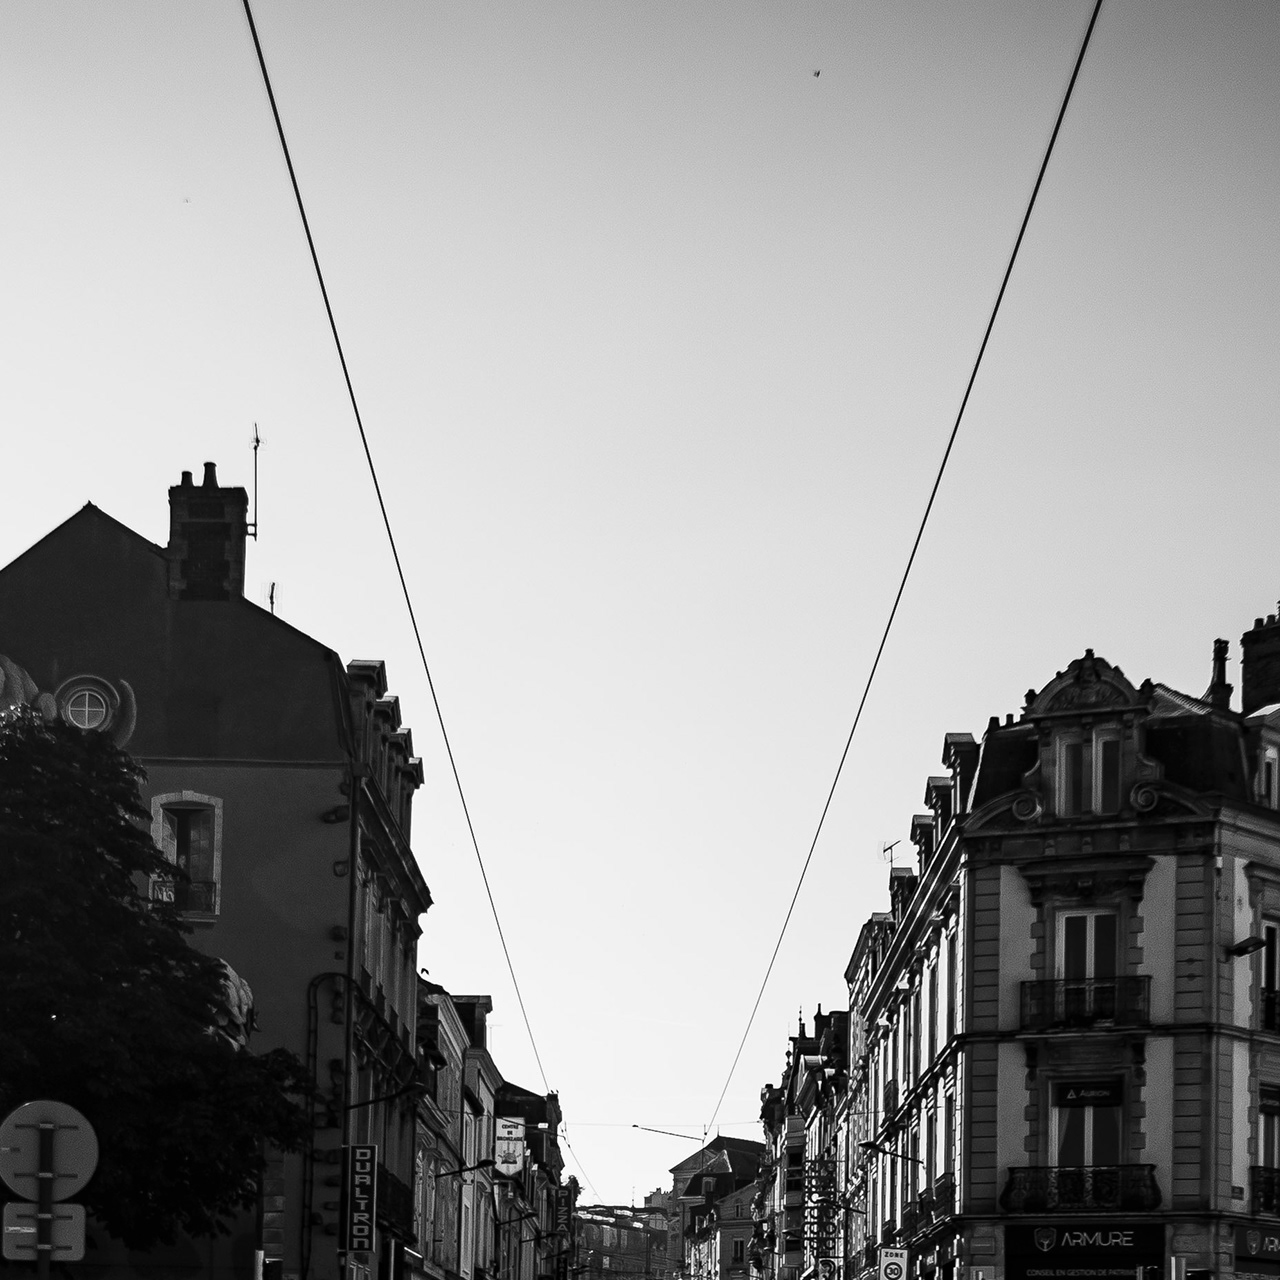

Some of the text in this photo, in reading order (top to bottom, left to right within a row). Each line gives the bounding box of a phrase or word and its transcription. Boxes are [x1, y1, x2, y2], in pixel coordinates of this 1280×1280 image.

[352, 1148, 372, 1249] DUALTRON
[557, 1190, 569, 1232] PIZZA
[1061, 1231, 1135, 1247] ARMURE
[884, 1251, 904, 1259] ZONE
[887, 1267, 899, 1276] 30
[1026, 1268, 1055, 1277] CONSEIL
[1056, 1268, 1066, 1277] EN
[1067, 1268, 1097, 1277] GESTION
[1098, 1268, 1108, 1277] DE
